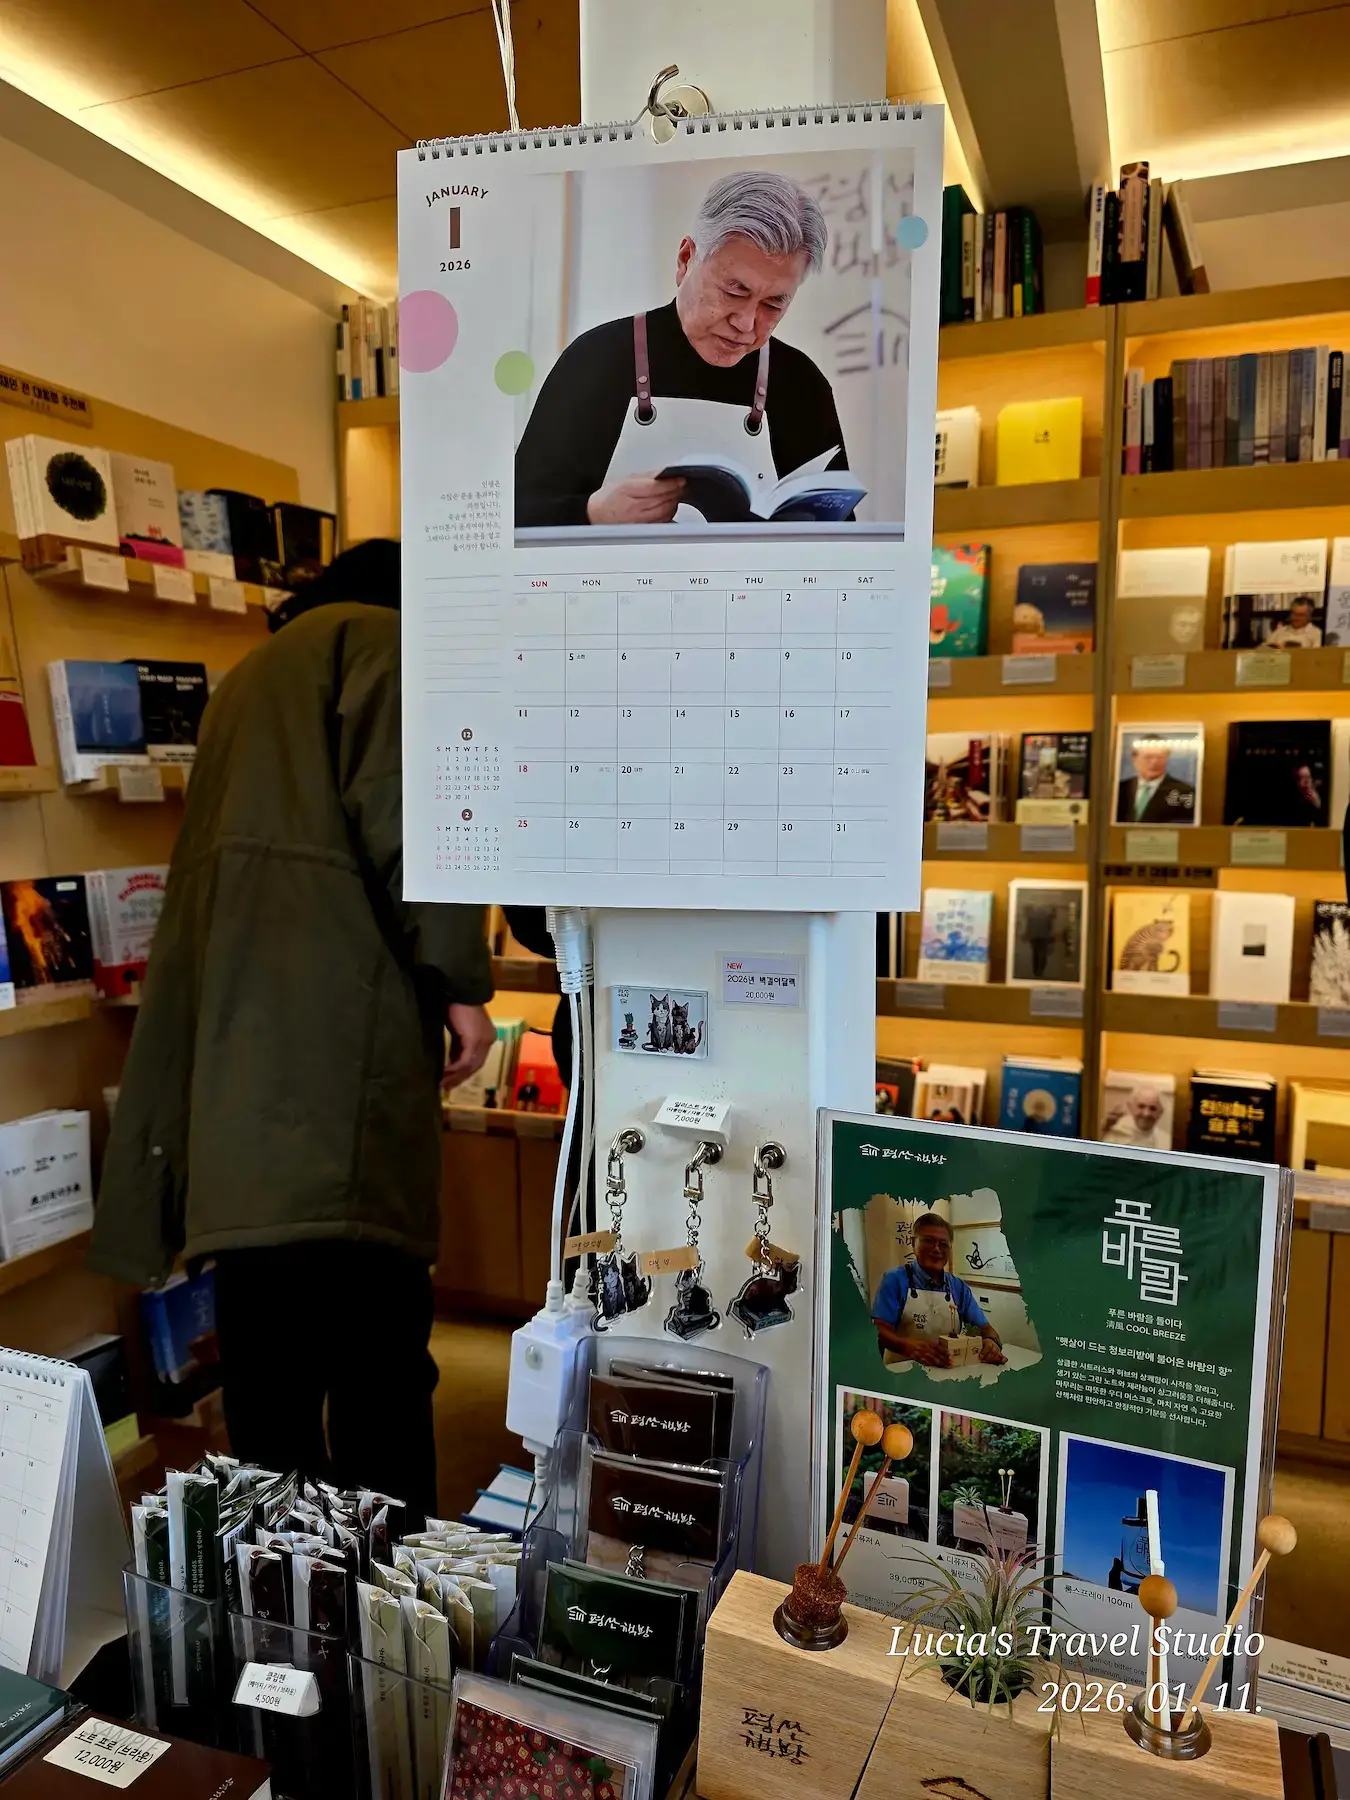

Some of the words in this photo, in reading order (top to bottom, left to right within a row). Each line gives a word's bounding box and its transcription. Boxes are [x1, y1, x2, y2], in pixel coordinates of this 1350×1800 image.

[426, 185, 489, 207] JANUARY
[440, 260, 471, 272] 2026
[689, 577, 709, 585] WED
[857, 576, 874, 584] SAT
[841, 652, 852, 660] 10
[569, 709, 579, 718] 12
[622, 709, 632, 718] 13
[675, 710, 686, 718] 14
[730, 710, 740, 718] 15
[785, 710, 795, 718] 16
[840, 710, 850, 718] 17
[518, 765, 528, 773] 18
[569, 765, 579, 773] 19
[621, 766, 632, 774] 20
[674, 766, 684, 774] 21
[728, 767, 739, 775] 22
[783, 767, 794, 775] 23
[837, 767, 848, 775] 24
[517, 820, 528, 828] 25
[568, 821, 579, 829] 26
[621, 821, 631, 830] 27
[674, 822, 685, 830] 28
[727, 823, 738, 831] 29
[781, 823, 793, 832] 30
[836, 824, 846, 832] 31
[727, 974, 754, 985] 2026년
[674, 1115, 701, 1124] 7,000원
[881, 1148, 947, 1165] 평산책방
[1108, 1308, 1126, 1319] 푸른
[1127, 1312, 1153, 1325] 바람을
[1156, 1316, 1183, 1329] 들이다
[1125, 1324, 1150, 1335] COOL
[1152, 1329, 1186, 1341] BREEZE
[1088, 1342, 1106, 1353] 드는
[1108, 1345, 1154, 1362] 청보리밭에
[1157, 1354, 1185, 1368] 불어온
[1187, 1360, 1215, 1374] 바람의
[1057, 1358, 1078, 1368] 상큼한
[1079, 1362, 1114, 1375] 시트러스와
[1116, 1369, 1138, 1380] 허브의
[1170, 1380, 1192, 1390] 시작을
[1194, 1384, 1219, 1397] 알리고,
[1055, 1379, 1084, 1391] 마무리는
[1085, 1385, 1106, 1396] 따뜻한
[1108, 1389, 1122, 1398] 우디
[1124, 1393, 1155, 1406] 머스크로,
[1157, 1399, 1172, 1409] 마치
[1173, 1402, 1188, 1412] 자연
[1190, 1406, 1198, 1414] 속
[1199, 1408, 1222, 1419] 고요한
[1056, 1369, 1070, 1378] 생기
[1072, 1372, 1086, 1380] 있는
[1088, 1374, 1102, 1384] 그린
[1104, 1377, 1125, 1388] 노트와
[1127, 1382, 1155, 1394] 제라늄이
[1158, 1388, 1194, 1402] 싱그러움을
[1195, 1395, 1235, 1411] 더해줍니다.
[1055, 1390, 1083, 1402] 산책처럼
[1085, 1396, 1113, 1407] 편안하고
[1115, 1401, 1143, 1414] 안정적인
[1145, 1408, 1167, 1419] 기분을
[1169, 1413, 1208, 1428] 선사합니다.
[631, 1414, 691, 1433] 평산책방
[633, 1504, 696, 1526] 평산책방
[1064, 1584, 1105, 1602] 룸스프레이
[1106, 1596, 1133, 1609] 100ml
[588, 1613, 653, 1638] 평산책방
[255, 1694, 281, 1707] 4,500원
[74, 1730, 98, 1743] 노트
[94, 1737, 118, 1751] 프로
[114, 1744, 154, 1764] (브라운)
[74, 1749, 125, 1774] 12,000원
